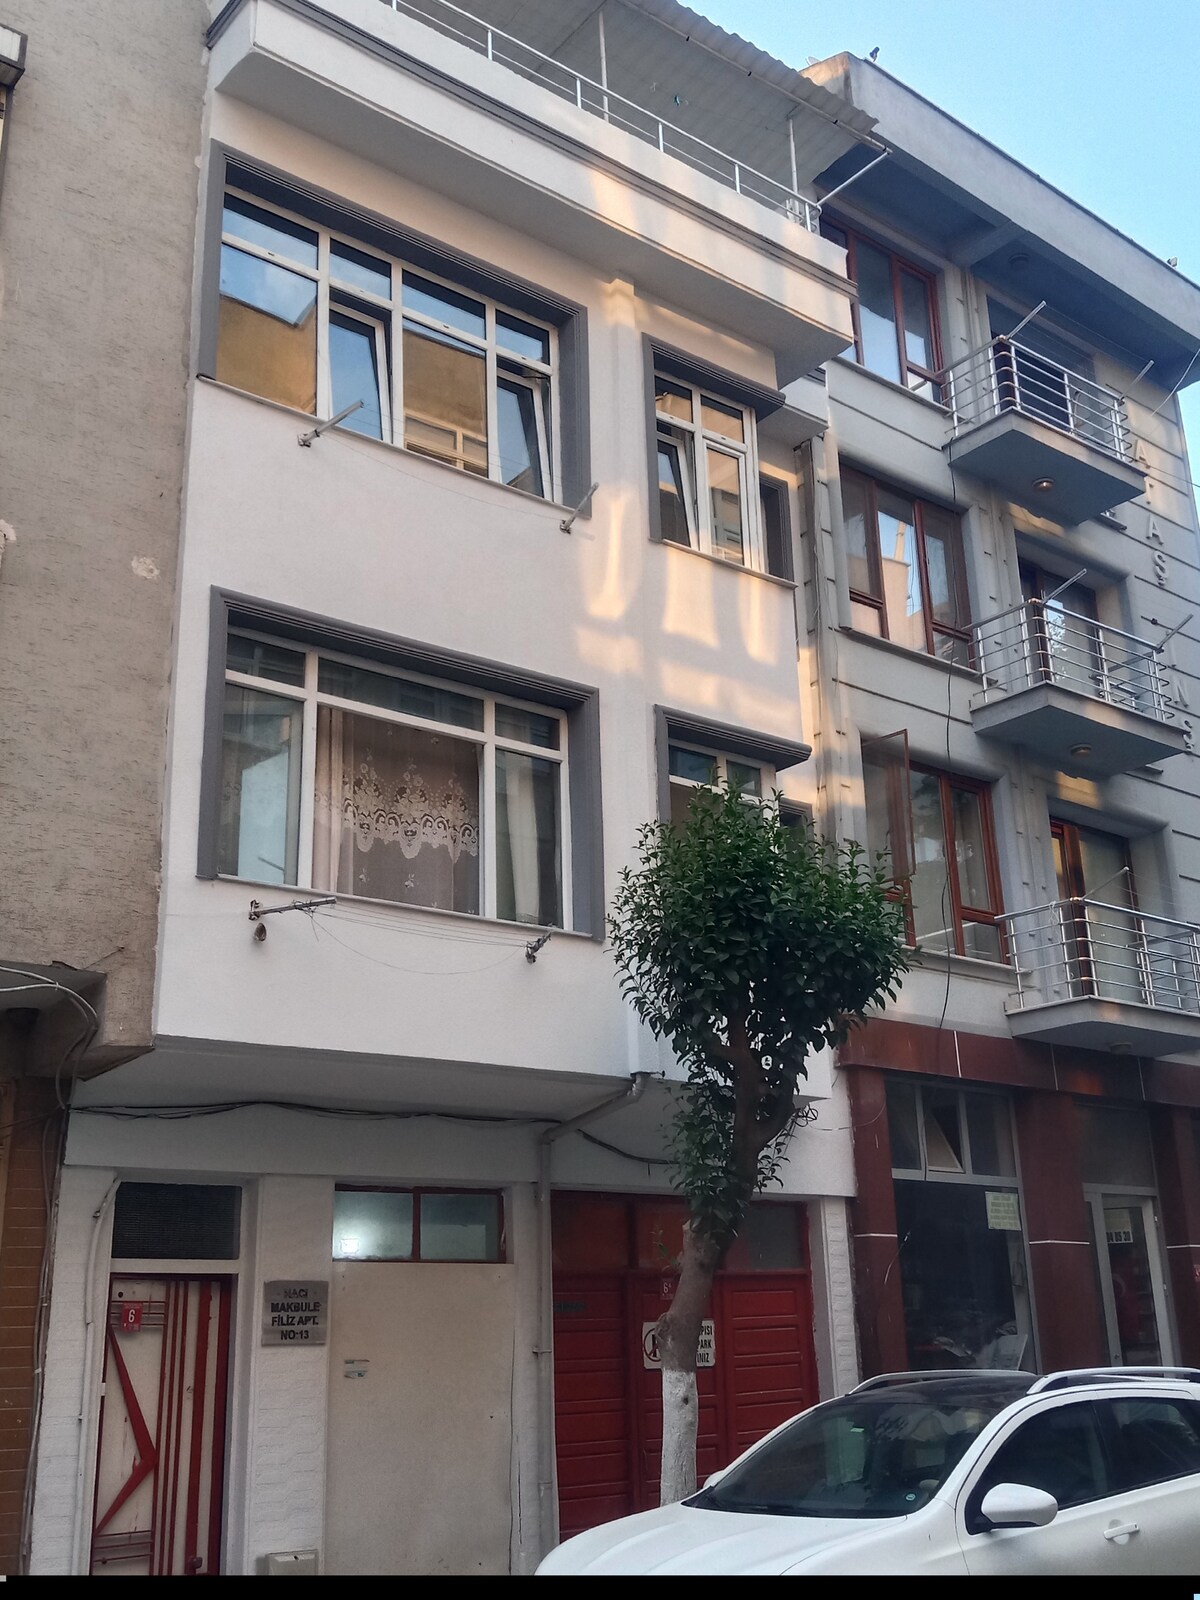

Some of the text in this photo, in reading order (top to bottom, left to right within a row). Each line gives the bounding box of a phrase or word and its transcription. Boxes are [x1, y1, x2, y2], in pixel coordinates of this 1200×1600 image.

[270, 1302, 320, 1313] MAKBULE
[128, 1308, 136, 1323] 6
[271, 1314, 319, 1326] FİLİZ APT.
